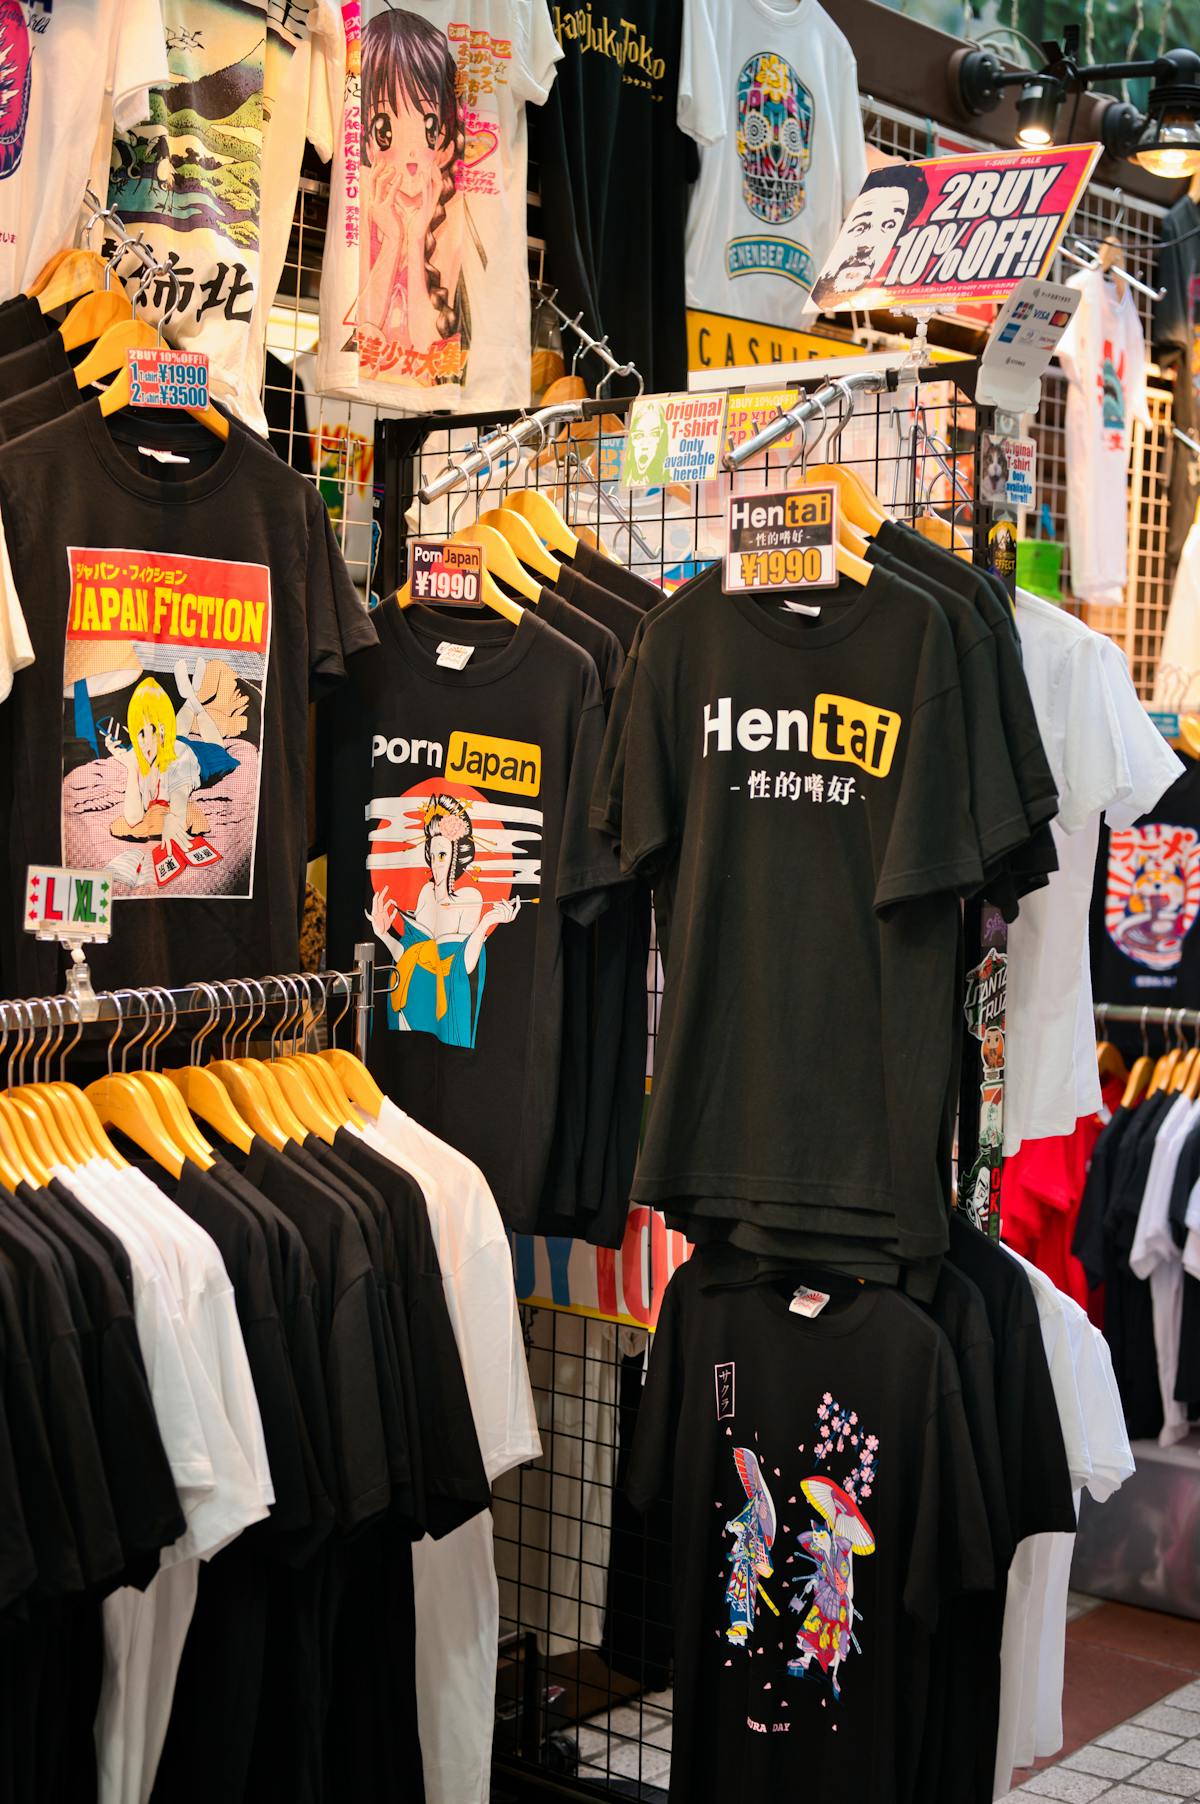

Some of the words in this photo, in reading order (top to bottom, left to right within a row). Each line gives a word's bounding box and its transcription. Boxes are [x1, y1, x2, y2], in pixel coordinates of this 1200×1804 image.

[929, 168, 1061, 222] 2BUY
[884, 215, 1061, 286] 10%OFF!!
[129, 350, 157, 361] 2BUY
[131, 362, 138, 381] 1
[158, 364, 207, 386] ¥1990
[131, 383, 140, 402] 2
[160, 385, 207, 407] ¥3500
[665, 399, 723, 421] Original
[730, 412, 748, 428] 1P
[671, 419, 718, 439] T-shirt
[679, 439, 704, 455] Only
[1005, 441, 1033, 457] Original
[664, 451, 715, 468] available
[1007, 456, 1030, 471] T-shirt
[672, 466, 706, 481] here!!
[732, 496, 828, 530] Hentai
[414, 547, 442, 563] Porn
[445, 549, 478, 567] Japan
[741, 548, 821, 587] ¥1990
[415, 571, 477, 600] ¥1990
[72, 583, 149, 633] JAPAN
[153, 587, 265, 644] FICTION
[703, 696, 891, 770] Hentai
[371, 734, 444, 769] Porn
[450, 741, 537, 784] Japan
[747, 770, 856, 806] 性的嗜好
[44, 877, 63, 920] L
[72, 880, 97, 922] XL
[719, 1370, 731, 1411] サクラ
[772, 1722, 790, 1732] DAY
